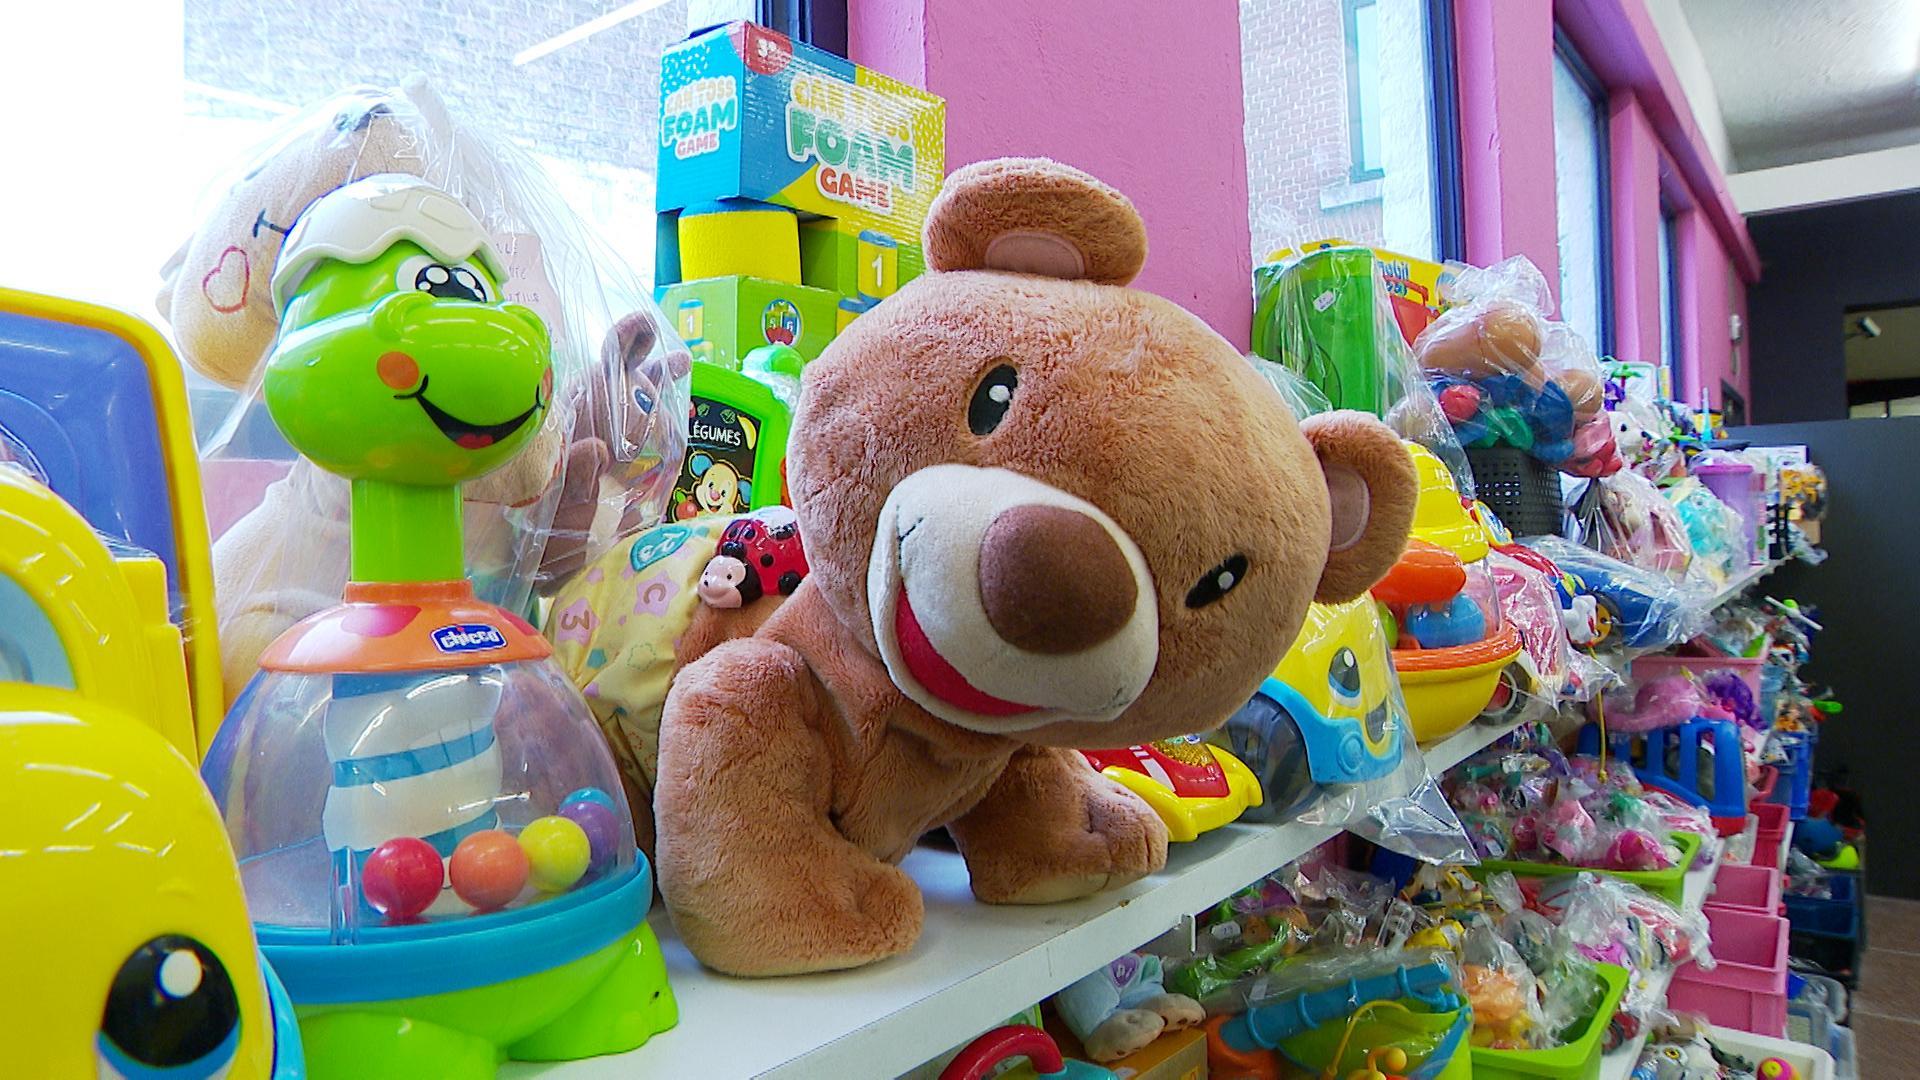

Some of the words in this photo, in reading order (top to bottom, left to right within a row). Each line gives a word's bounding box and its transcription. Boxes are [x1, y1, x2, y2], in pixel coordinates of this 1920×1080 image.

[663, 98, 736, 143] FOAM
[677, 132, 718, 156] GAME
[790, 107, 914, 190] FOAM
[820, 167, 889, 208] GAME
[871, 253, 883, 289] 1
[687, 314, 694, 334] 1
[440, 626, 500, 648] chicco
